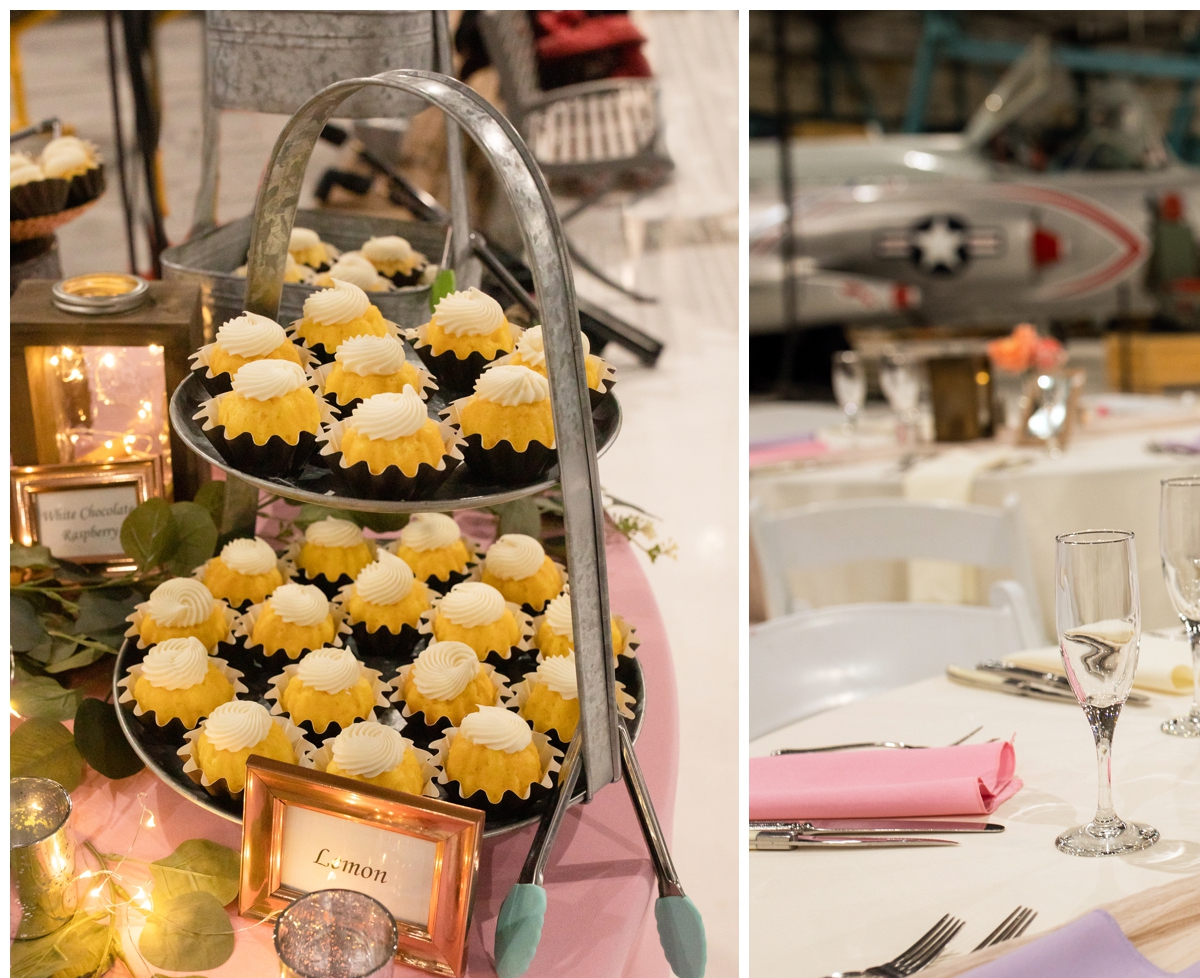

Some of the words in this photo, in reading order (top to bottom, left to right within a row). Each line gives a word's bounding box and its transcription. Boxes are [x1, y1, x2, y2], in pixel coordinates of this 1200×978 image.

[42, 507, 78, 521] White
[63, 524, 121, 542] Raspberry
[313, 848, 388, 884] Lemon
